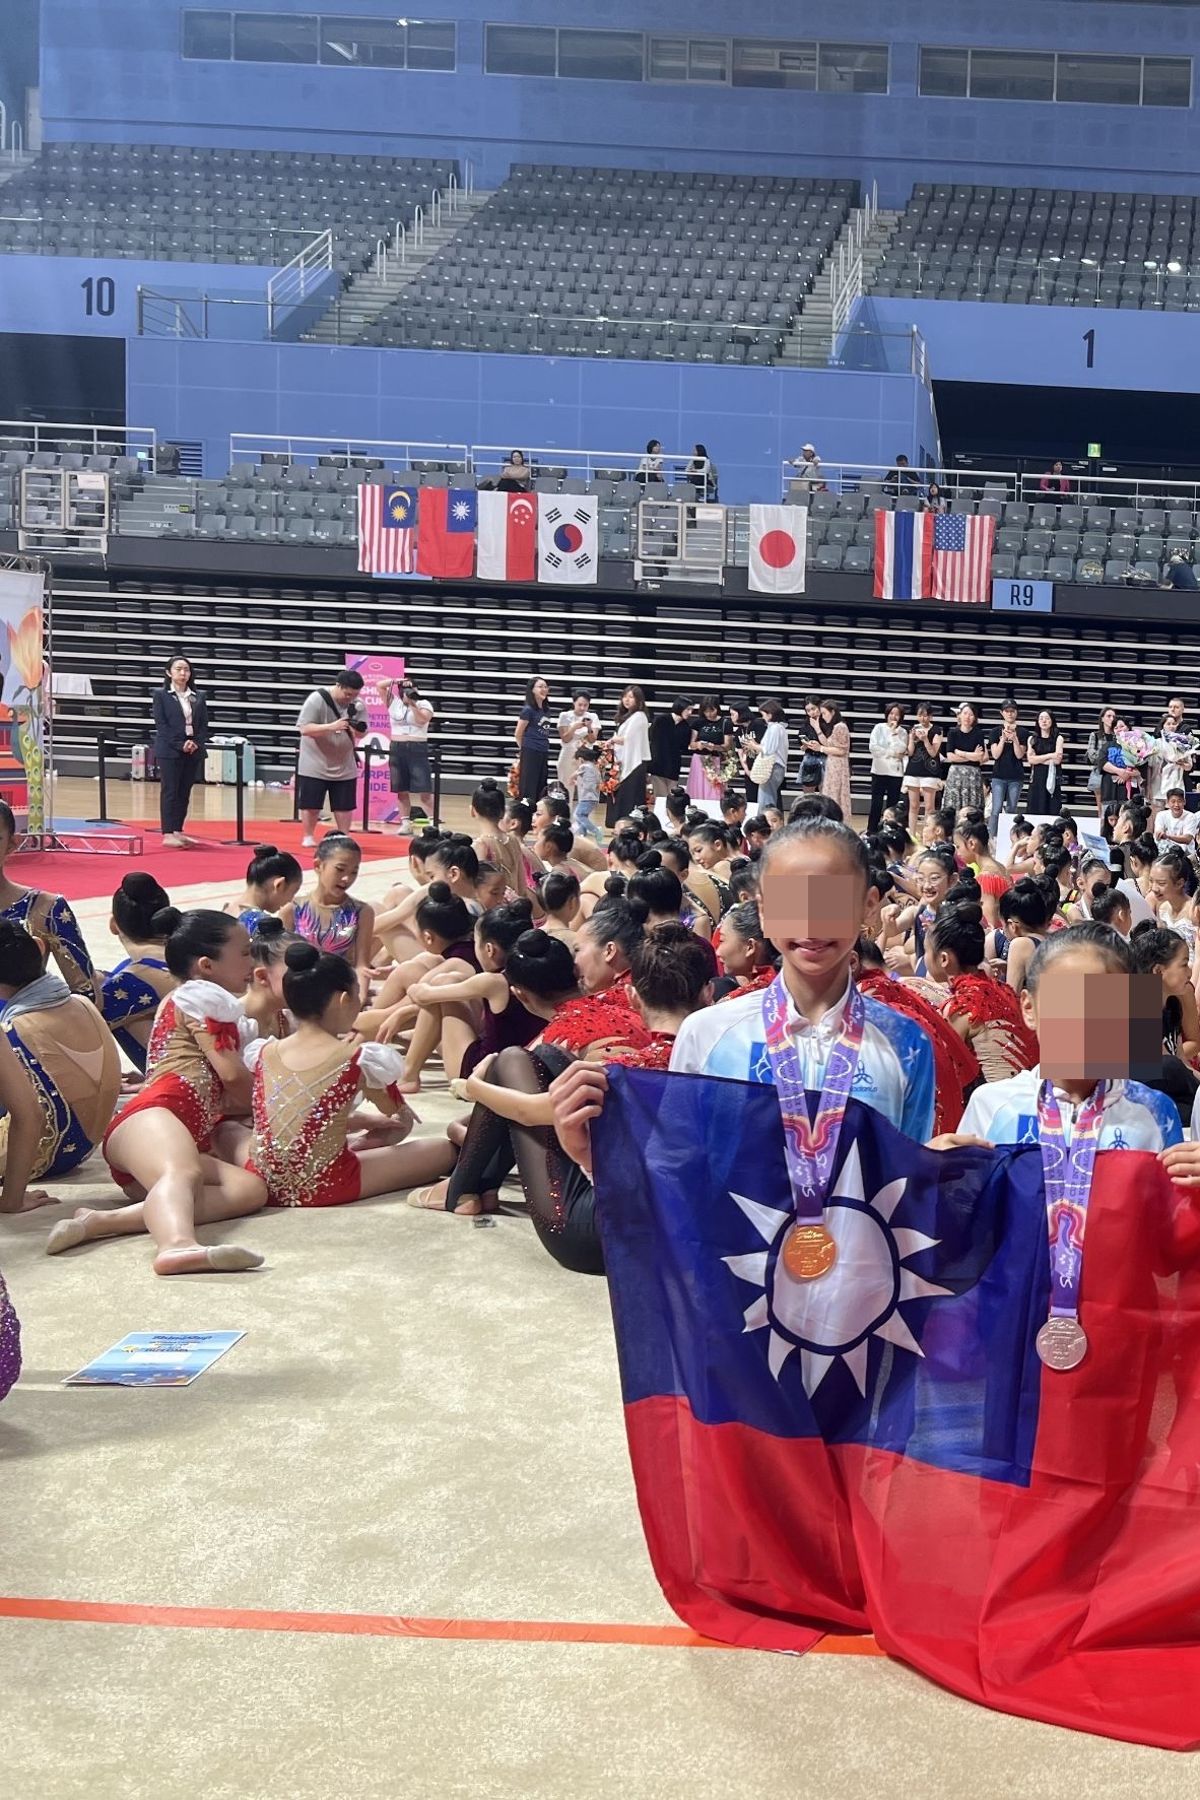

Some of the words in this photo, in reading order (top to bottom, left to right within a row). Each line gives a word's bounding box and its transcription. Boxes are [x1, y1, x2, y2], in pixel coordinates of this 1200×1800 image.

[81, 277, 115, 317] 10
[1082, 329, 1095, 368] 1
[1010, 584, 1034, 606] R9
[1060, 1257, 1074, 1289] Shine
